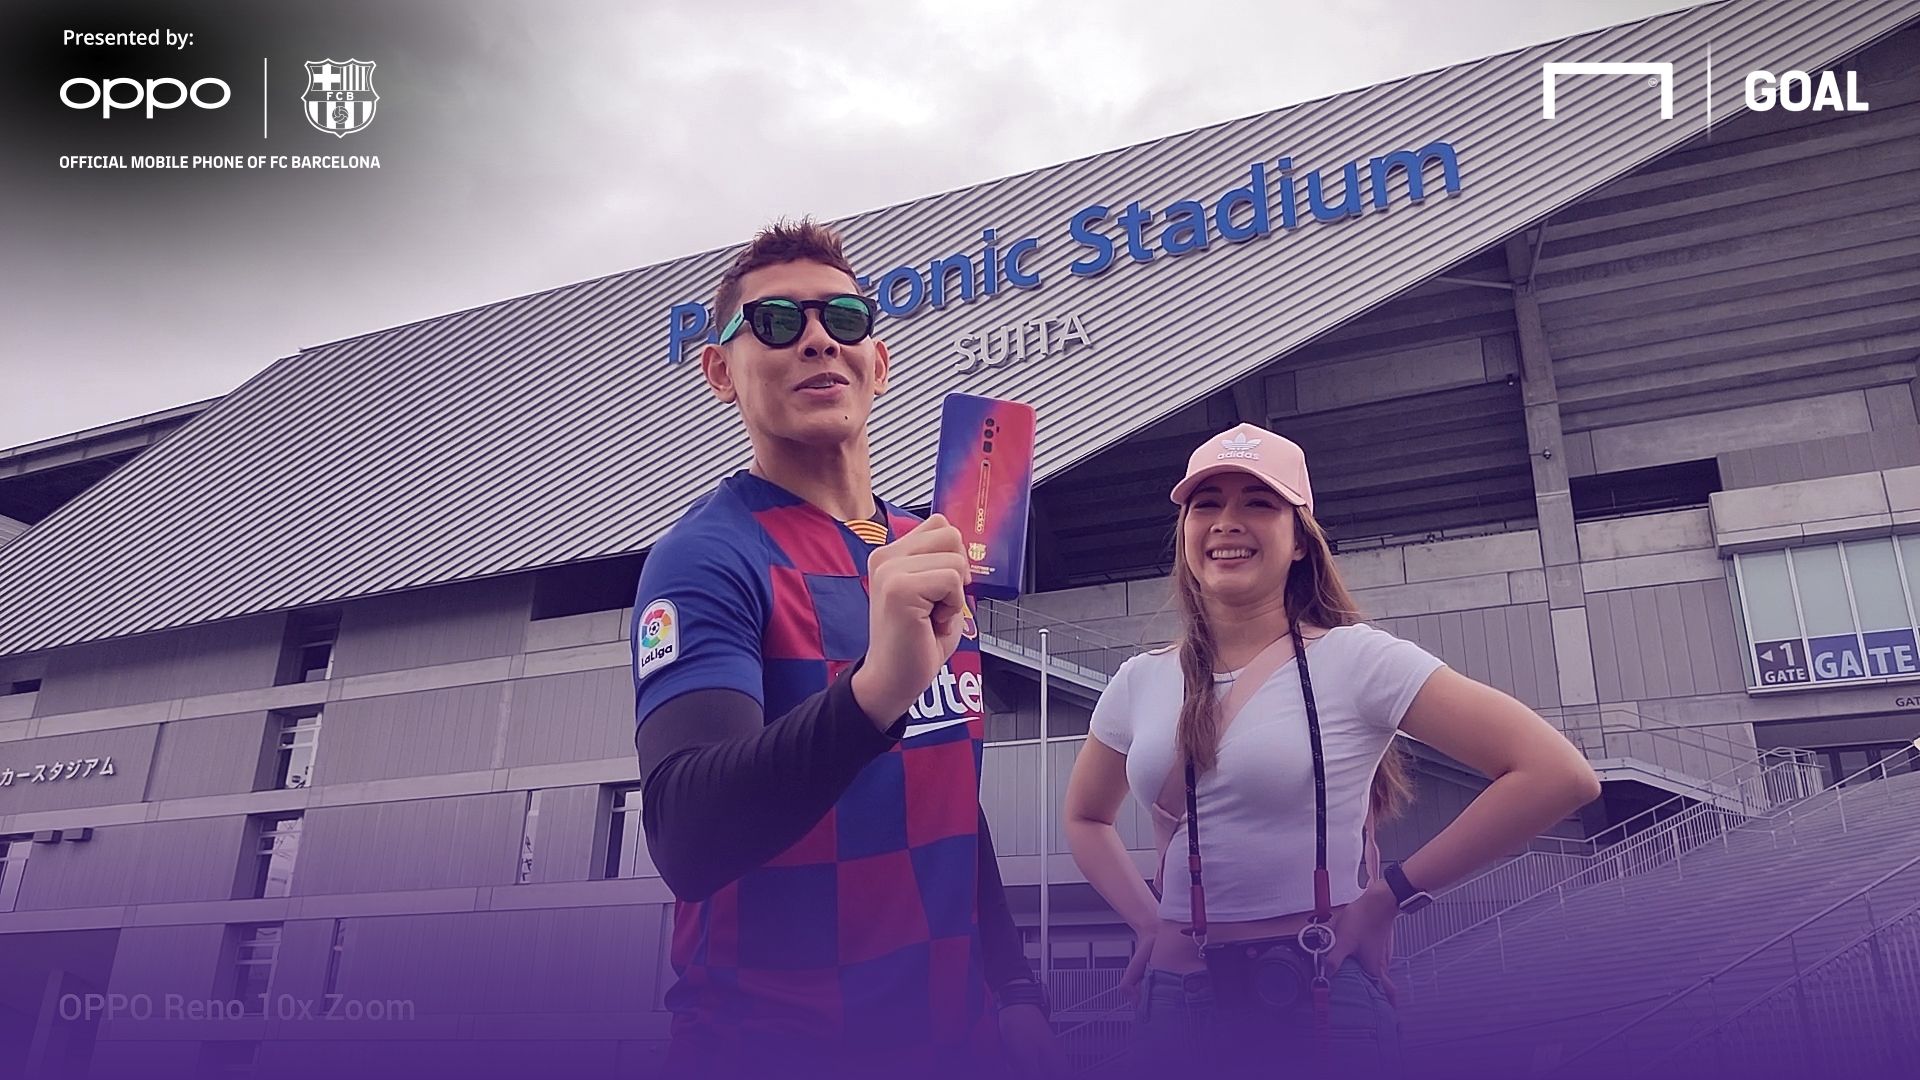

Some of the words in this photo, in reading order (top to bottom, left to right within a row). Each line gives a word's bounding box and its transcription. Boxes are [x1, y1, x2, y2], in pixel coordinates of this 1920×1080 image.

[1069, 141, 1461, 277] Stadium
[954, 315, 1092, 373] SUITA
[1217, 450, 1260, 460] adidas
[1779, 642, 1795, 667] 1
[1814, 645, 1916, 679] GATE
[1765, 668, 1807, 683] GATE
[0, 756, 114, 786] カースタジアム
